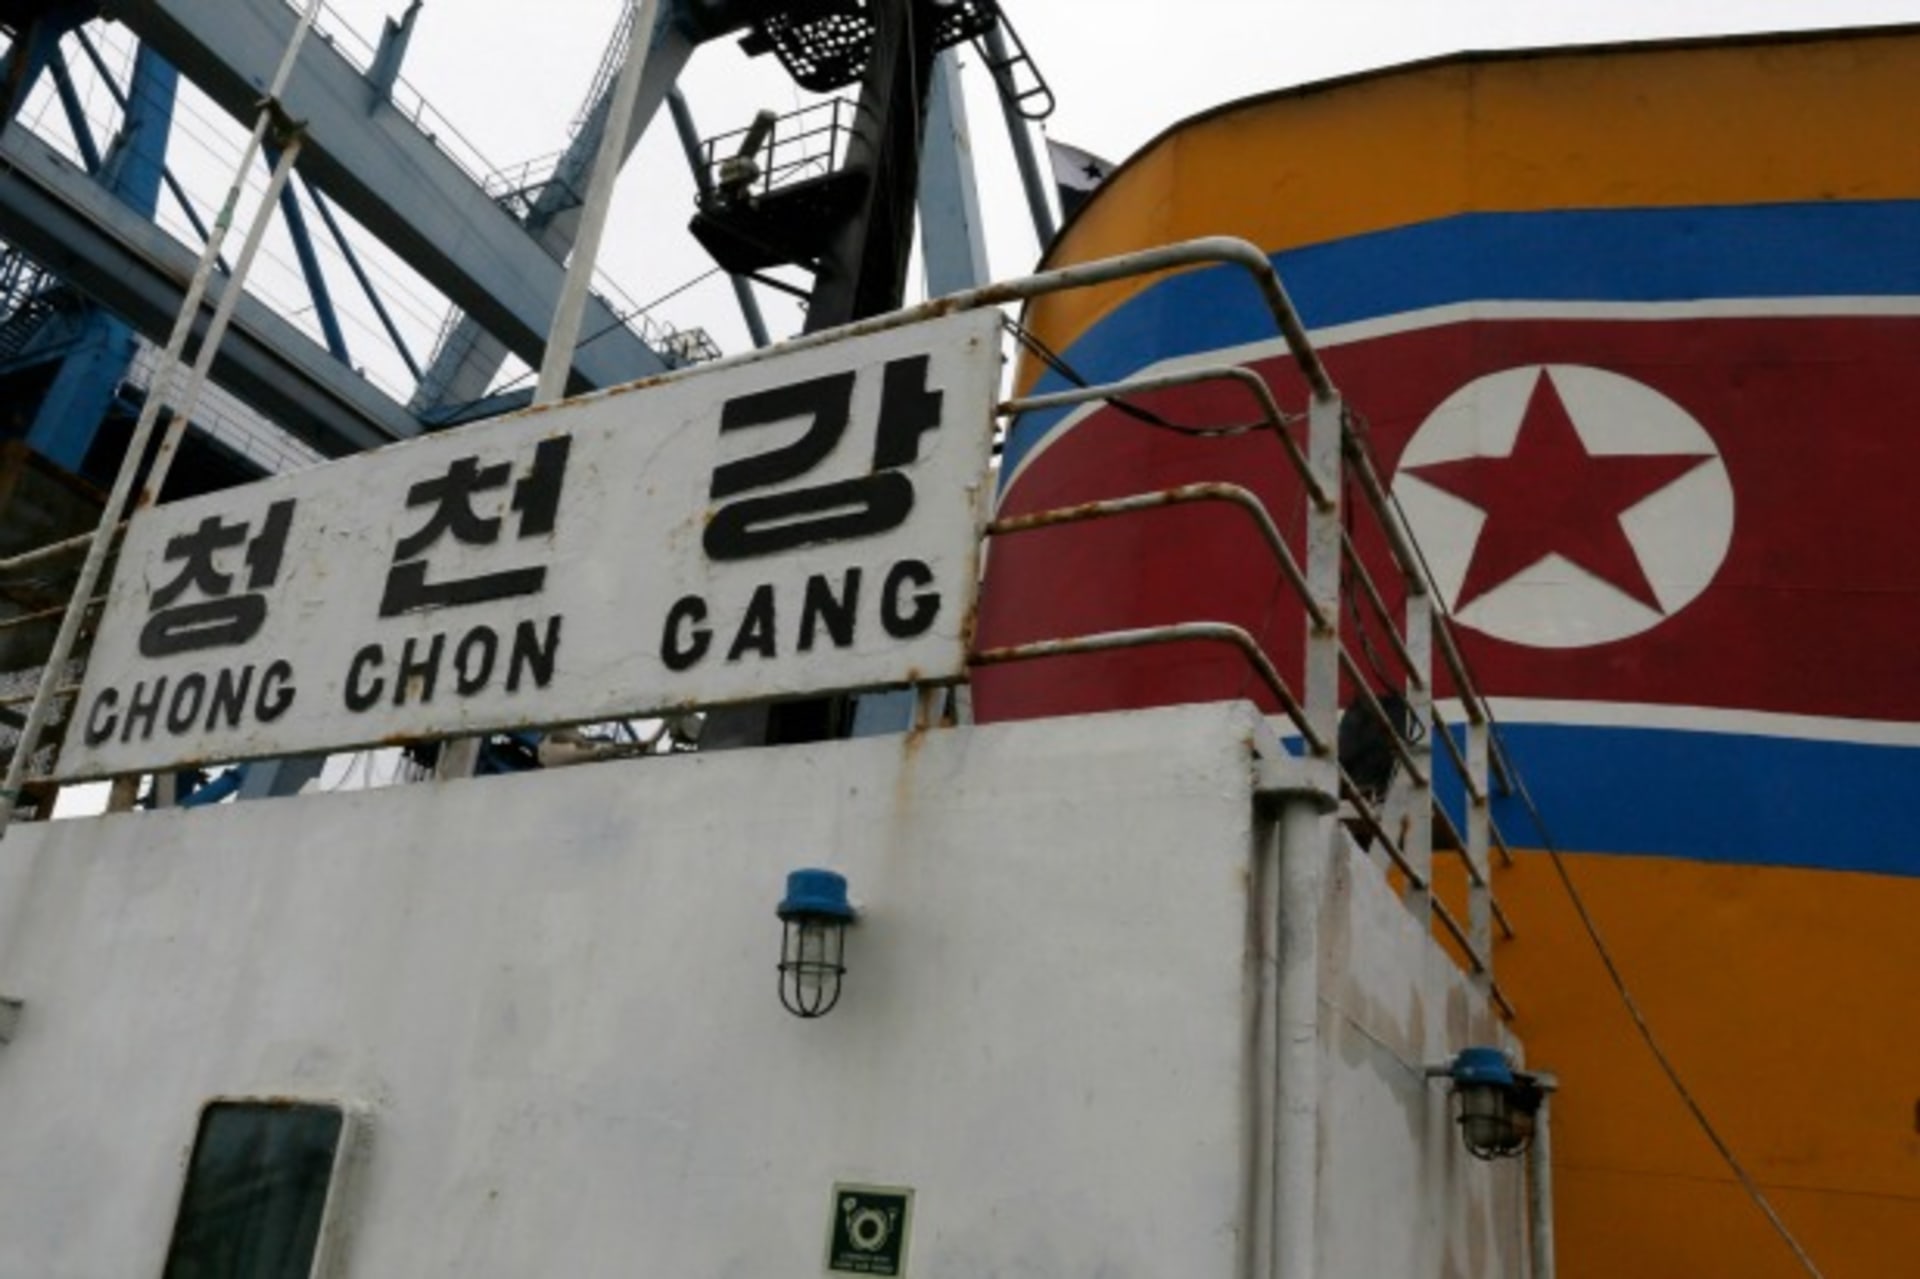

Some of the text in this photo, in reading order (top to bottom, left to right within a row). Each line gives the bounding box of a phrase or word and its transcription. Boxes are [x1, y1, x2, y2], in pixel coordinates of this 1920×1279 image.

[139, 354, 943, 658] 청 천 강
[84, 560, 941, 749] CHONG CHON GANG
